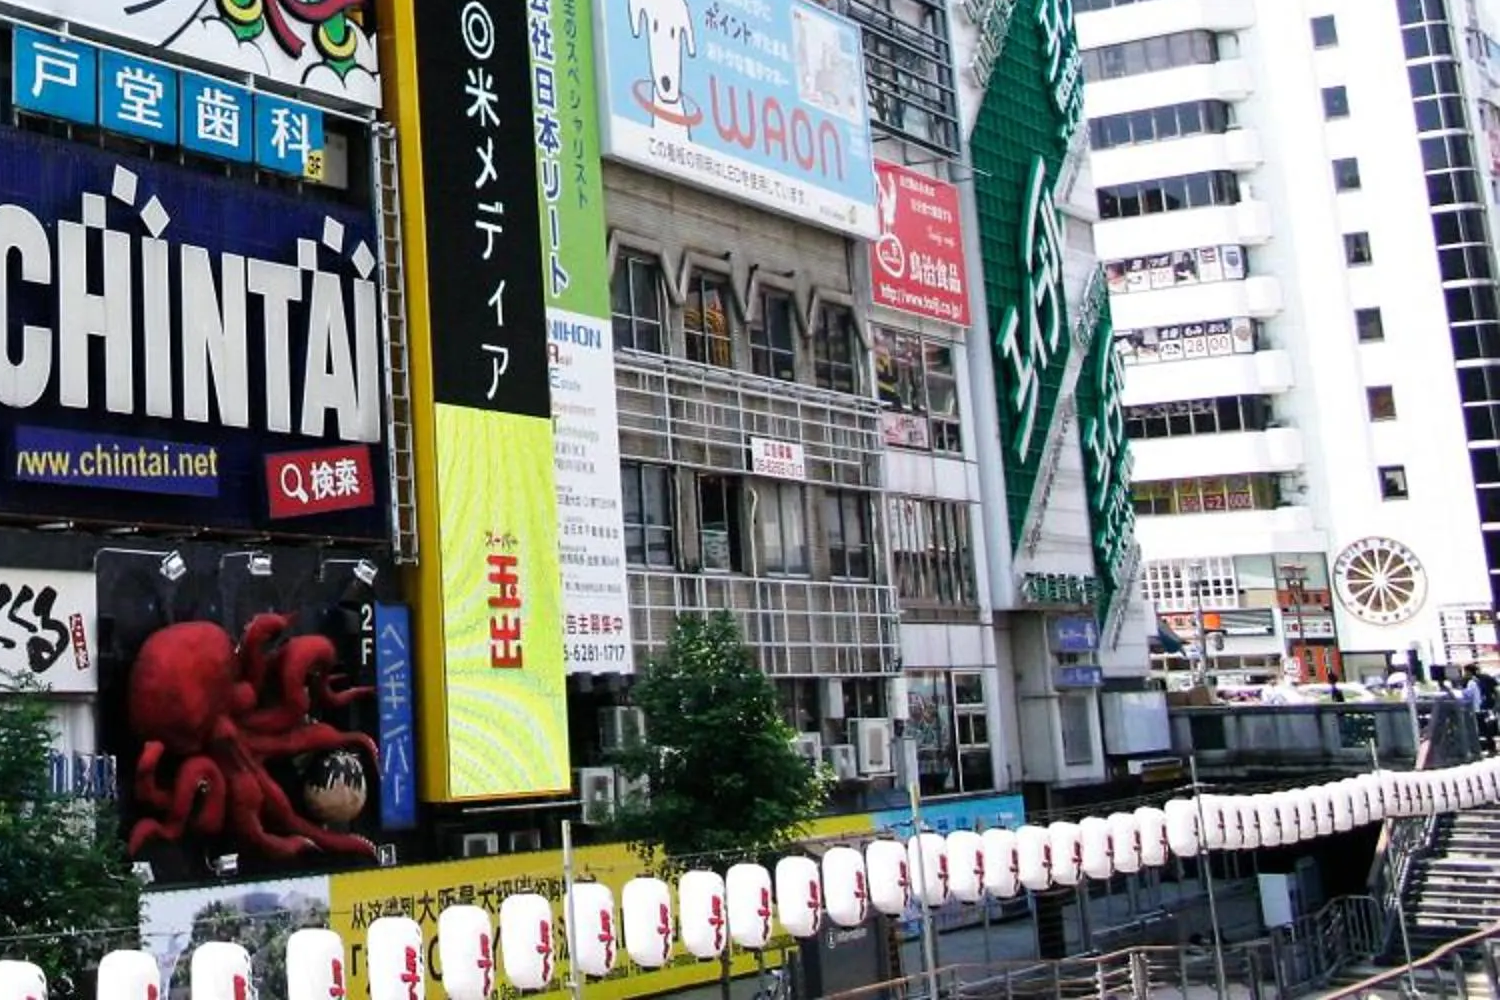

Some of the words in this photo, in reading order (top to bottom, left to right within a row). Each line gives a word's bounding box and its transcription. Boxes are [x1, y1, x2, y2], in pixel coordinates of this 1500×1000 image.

[32, 40, 311, 165] 戸堂歯科
[709, 74, 846, 182] WAON
[997, 153, 1063, 465] エイブル
[311, 458, 361, 501] 検索
[360, 603, 374, 666] 2F
[486, 554, 522, 669] 玉出
[561, 612, 624, 637] 告主募集中
